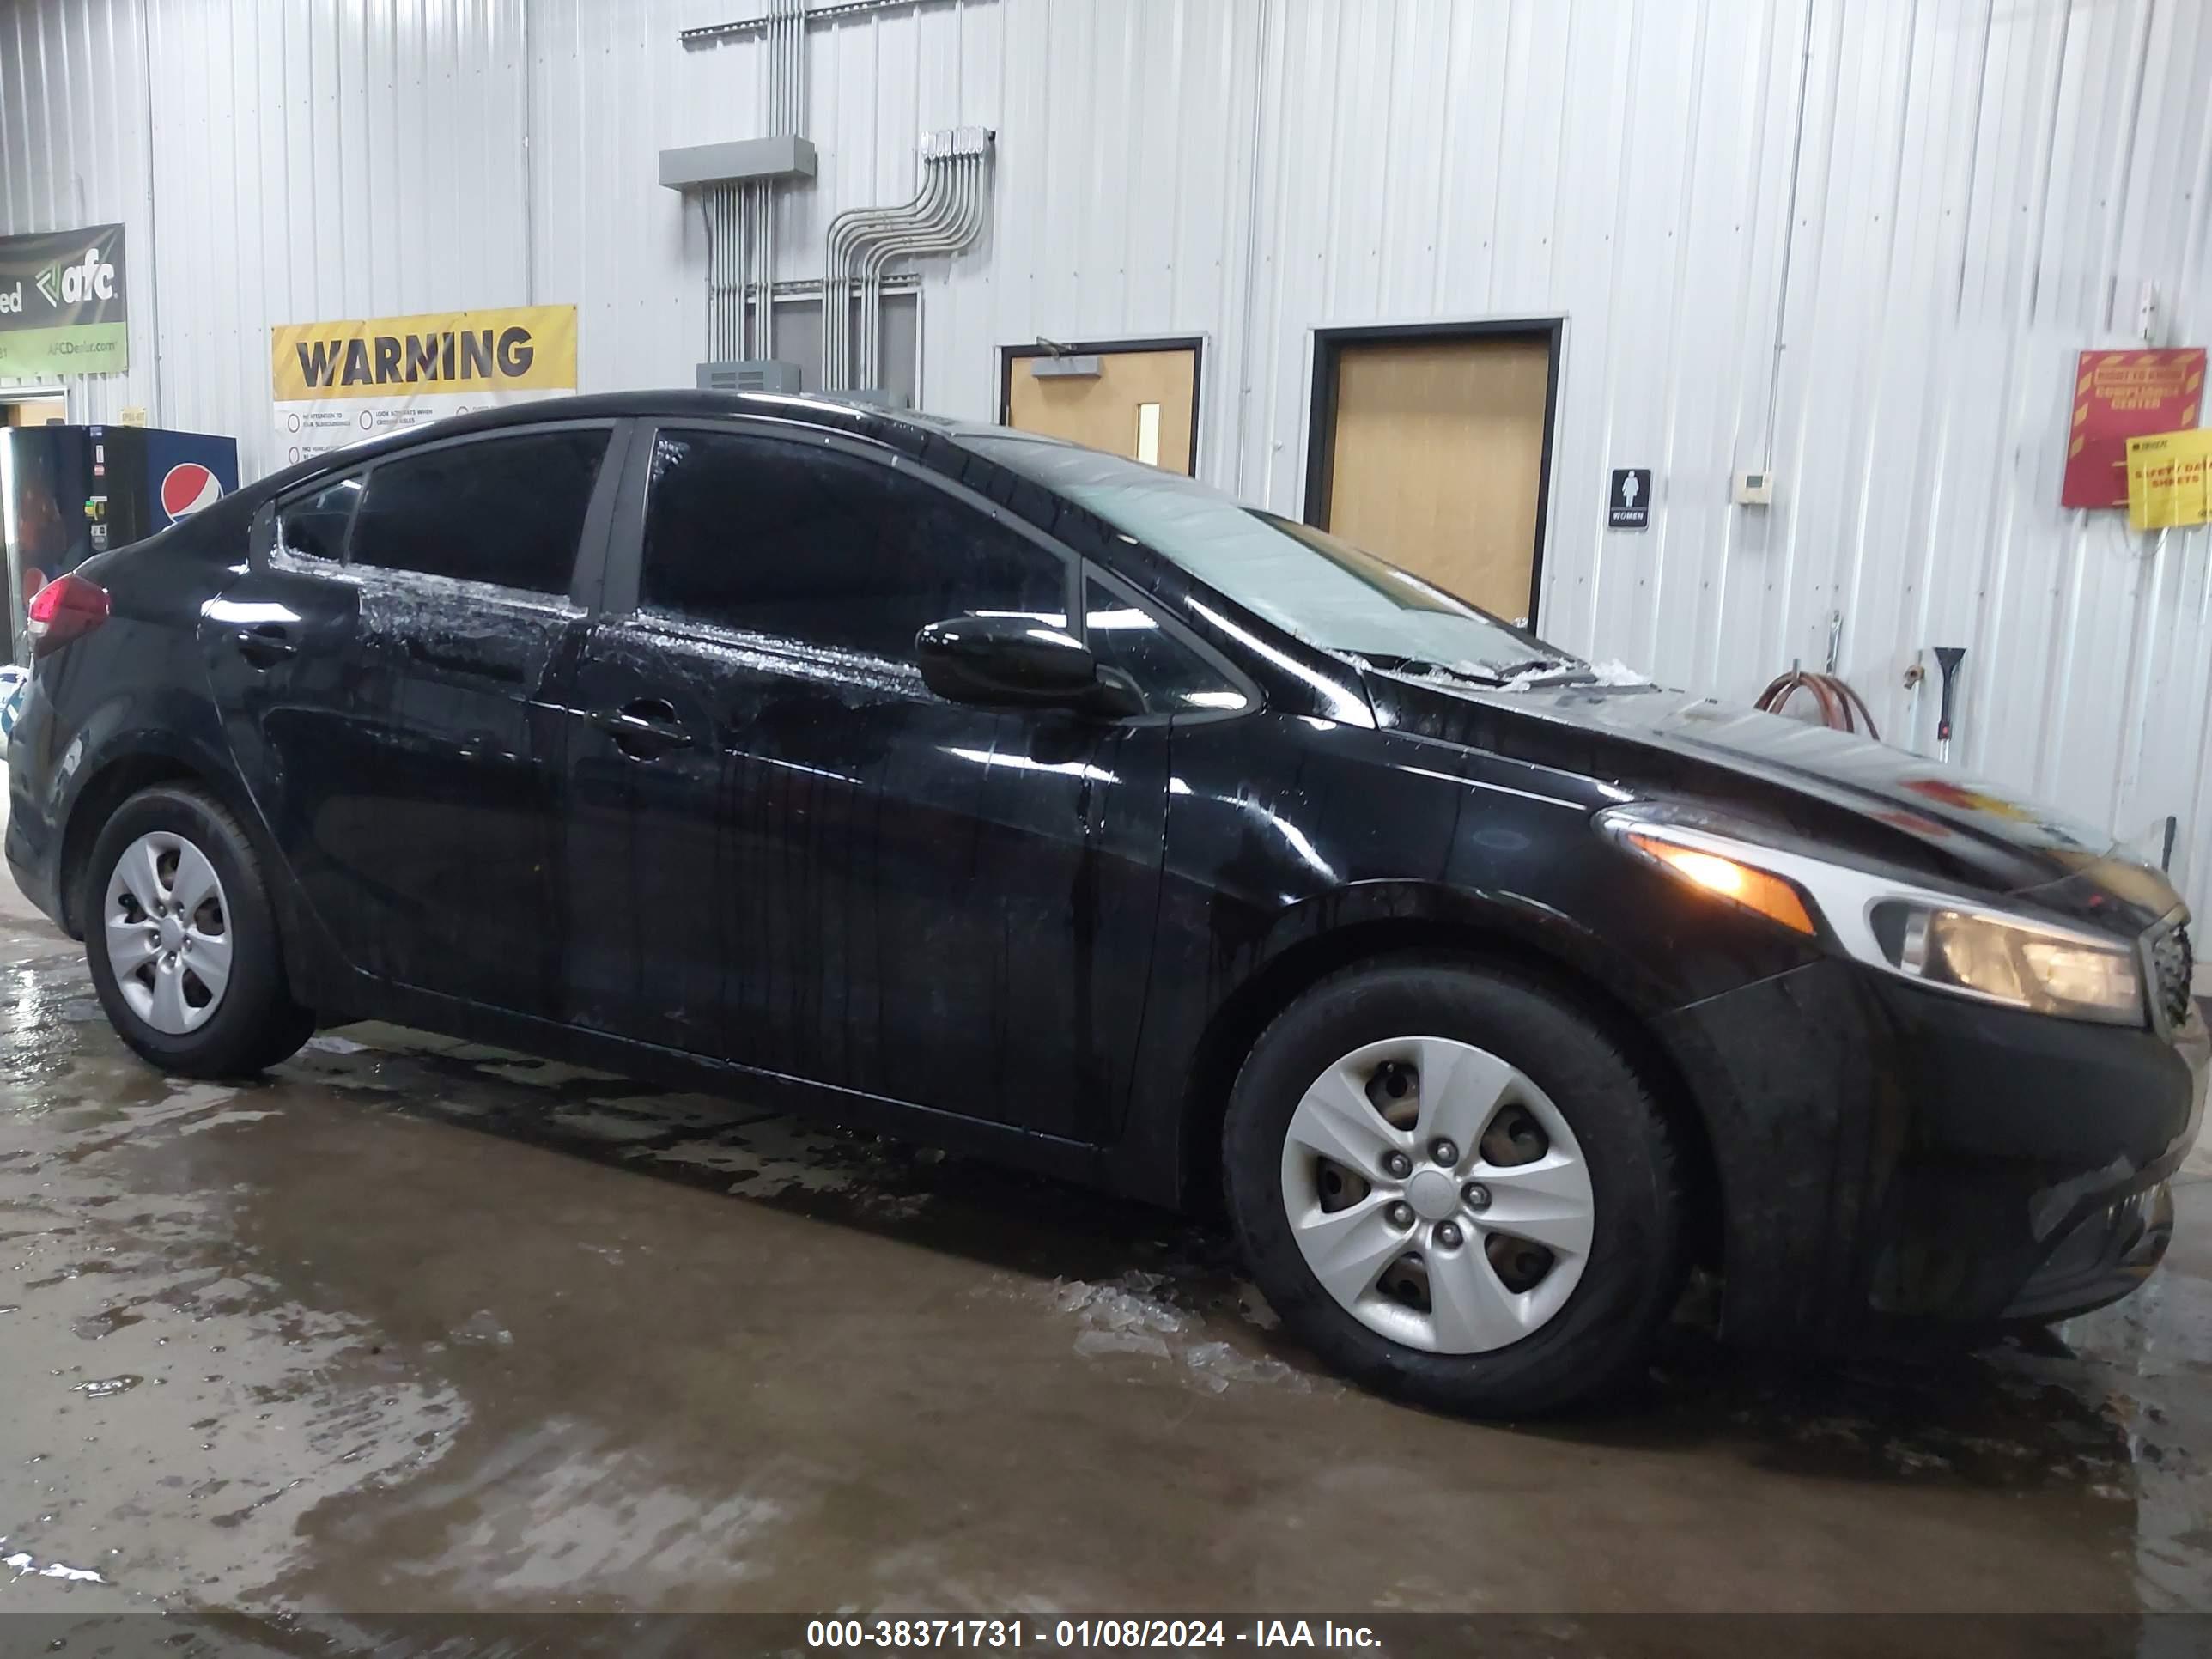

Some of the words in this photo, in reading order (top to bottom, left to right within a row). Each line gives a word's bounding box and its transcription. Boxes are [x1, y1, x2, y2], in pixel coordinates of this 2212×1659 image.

[0, 281, 22, 313] ed
[62, 248, 114, 303] afc
[296, 326, 534, 387] WARNING
[1613, 511, 1644, 521] WOMEN
